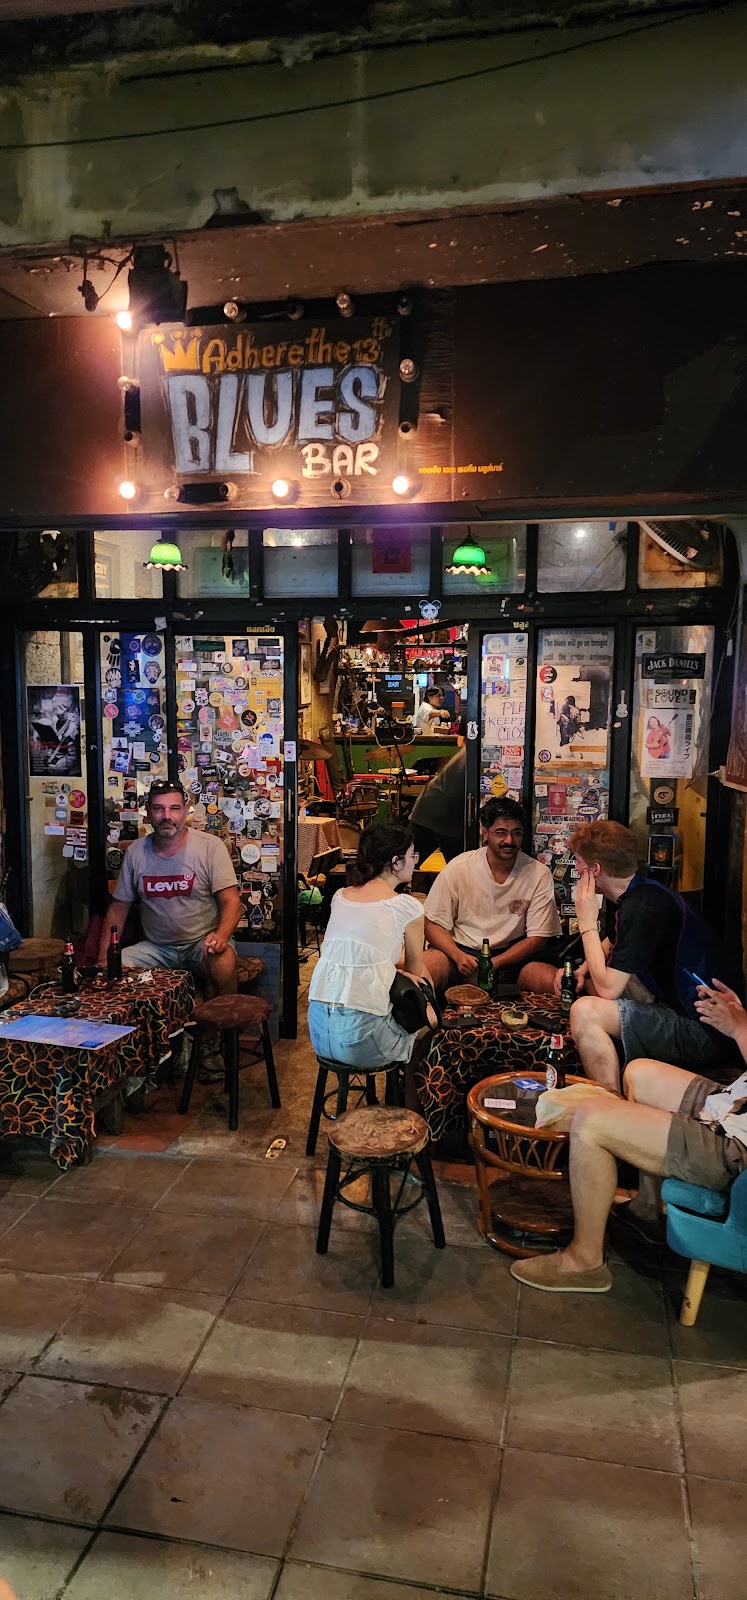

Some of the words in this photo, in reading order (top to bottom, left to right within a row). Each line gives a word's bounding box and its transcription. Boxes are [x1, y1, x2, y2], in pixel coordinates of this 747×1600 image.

[202, 332, 303, 373] Adhere
[304, 327, 350, 364] the
[168, 364, 379, 474] BLUES
[301, 442, 380, 478] BAR
[544, 638, 553, 647] The
[554, 638, 567, 647] blues
[567, 638, 576, 647] will
[576, 640, 583, 649] go
[590, 638, 609, 649] tonight
[647, 659, 668, 671] JACK
[668, 657, 700, 671] DANIEL'S
